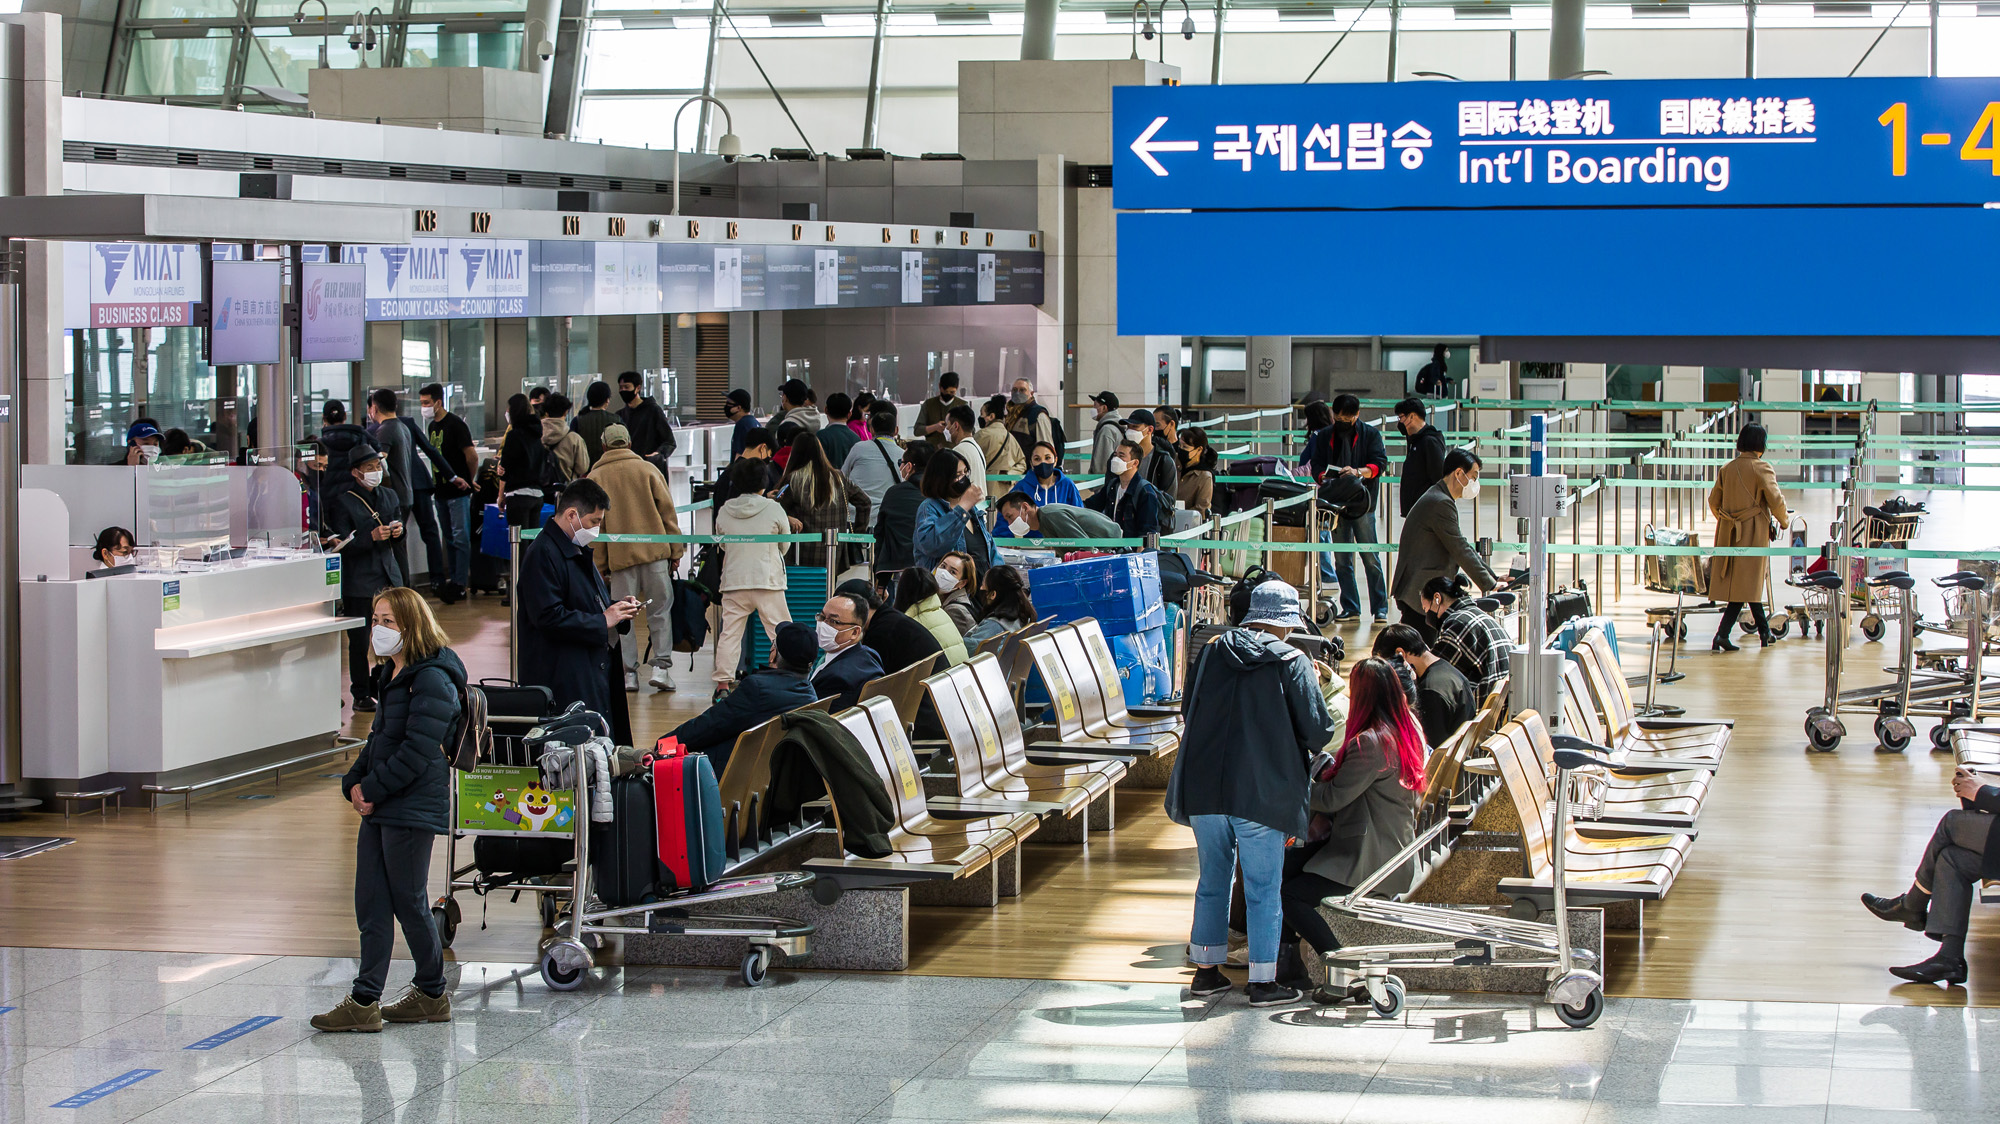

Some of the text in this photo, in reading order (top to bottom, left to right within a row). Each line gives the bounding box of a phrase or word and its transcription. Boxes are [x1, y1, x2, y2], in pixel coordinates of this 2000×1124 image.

[1458, 98, 1615, 136] 国际线登机
[1213, 120, 1433, 172] 국제선탑승
[1547, 146, 1730, 192] Boarding
[415, 210, 438, 232] K13
[471, 212, 492, 233] K12
[563, 216, 581, 236] K11
[609, 217, 626, 236] K10
[688, 220, 701, 238] K9
[727, 222, 738, 239] K8
[792, 224, 803, 241] K7
[826, 225, 836, 242] K6
[134, 244, 185, 281] MIAT
[409, 247, 448, 280] MIAT
[486, 249, 523, 280] MIAT
[134, 286, 185, 297] MONGOLIAN AIRLINES
[324, 281, 361, 298] AIR CHINA
[409, 285, 432, 294] MONGOLIAN
[486, 284, 523, 293] MONGOLIAN AIRLINES
[98, 305, 182, 325] BUSINESS CLASS
[234, 299, 279, 316] 中国南方航空
[380, 299, 449, 317] ECONOMY CLASS
[460, 298, 523, 315] ECONOMY CLASS
